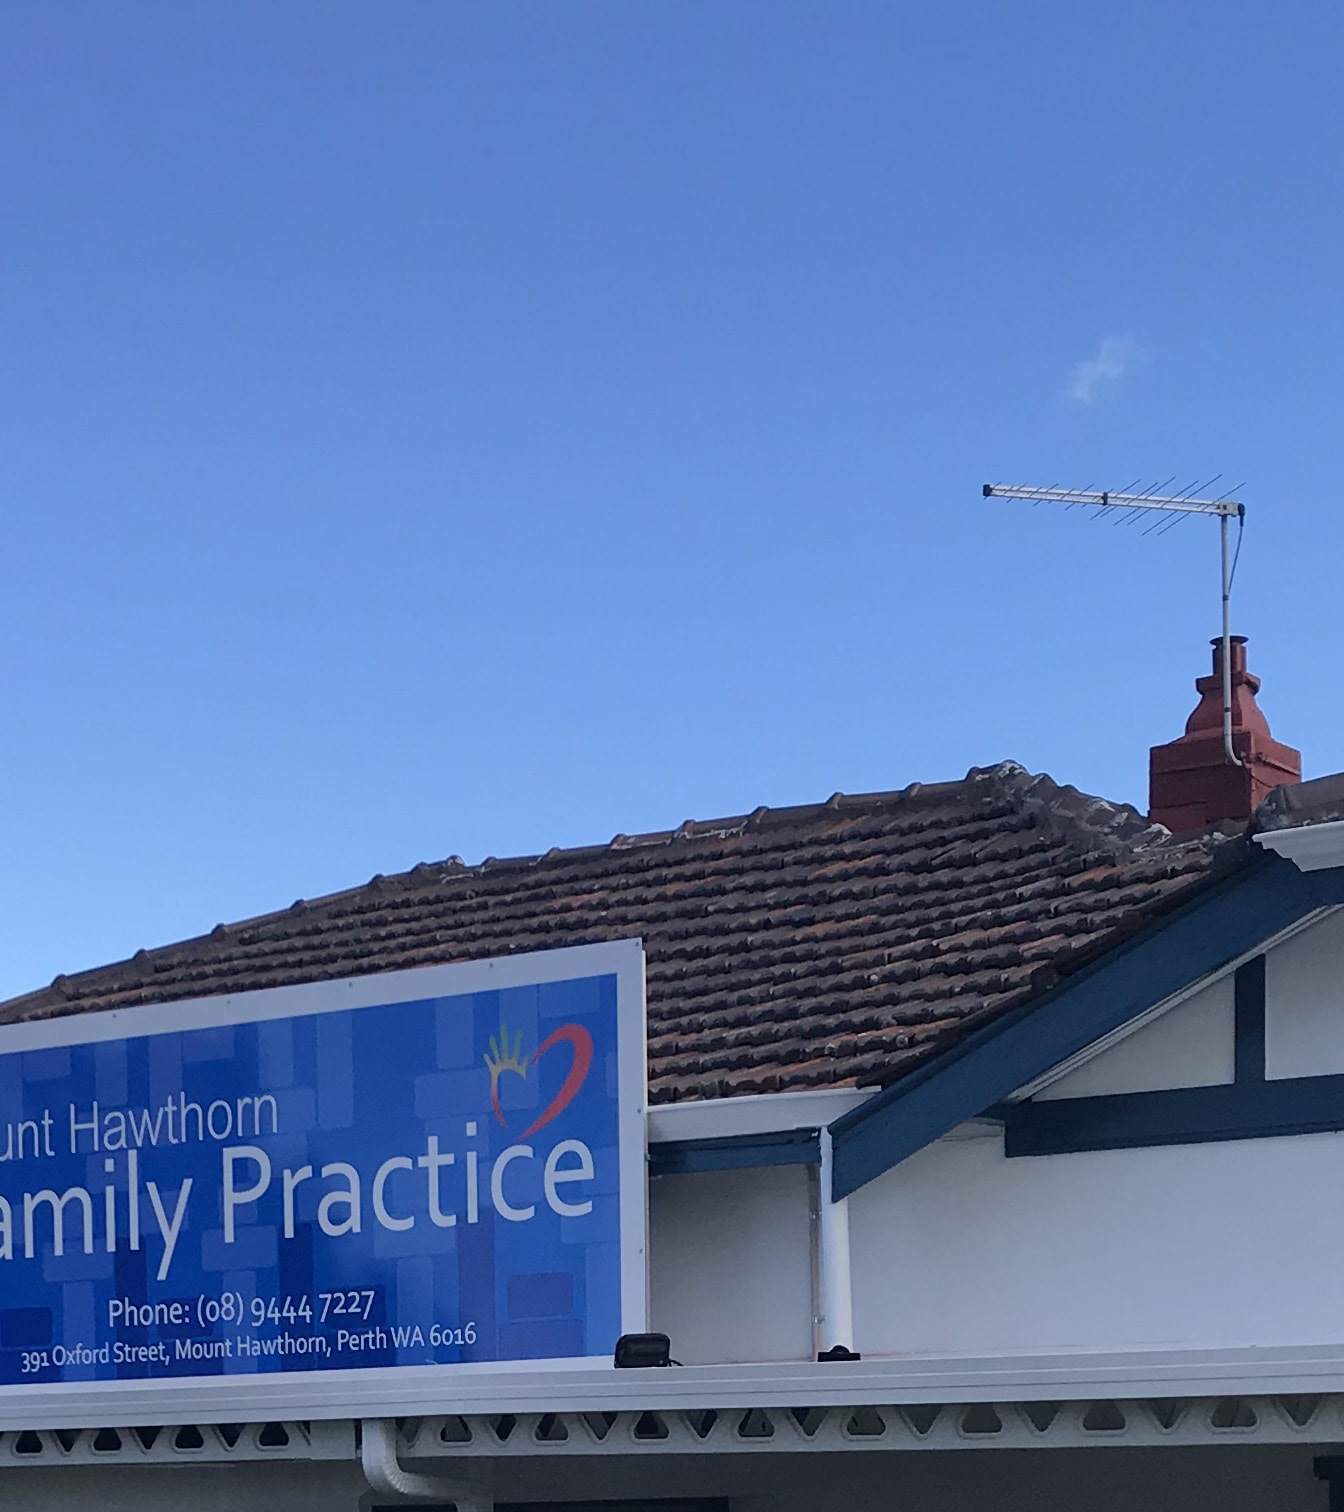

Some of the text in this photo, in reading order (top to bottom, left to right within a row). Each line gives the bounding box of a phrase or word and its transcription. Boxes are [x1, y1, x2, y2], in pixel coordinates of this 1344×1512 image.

[69, 1090, 278, 1154] Hawthorn
[222, 1120, 596, 1244] Practice
[108, 1290, 375, 1328] Phone: (08) 9444 7227
[21, 1321, 477, 1373] 391 Oxford Street, Mount Hawthorn, Perth WA 6016
